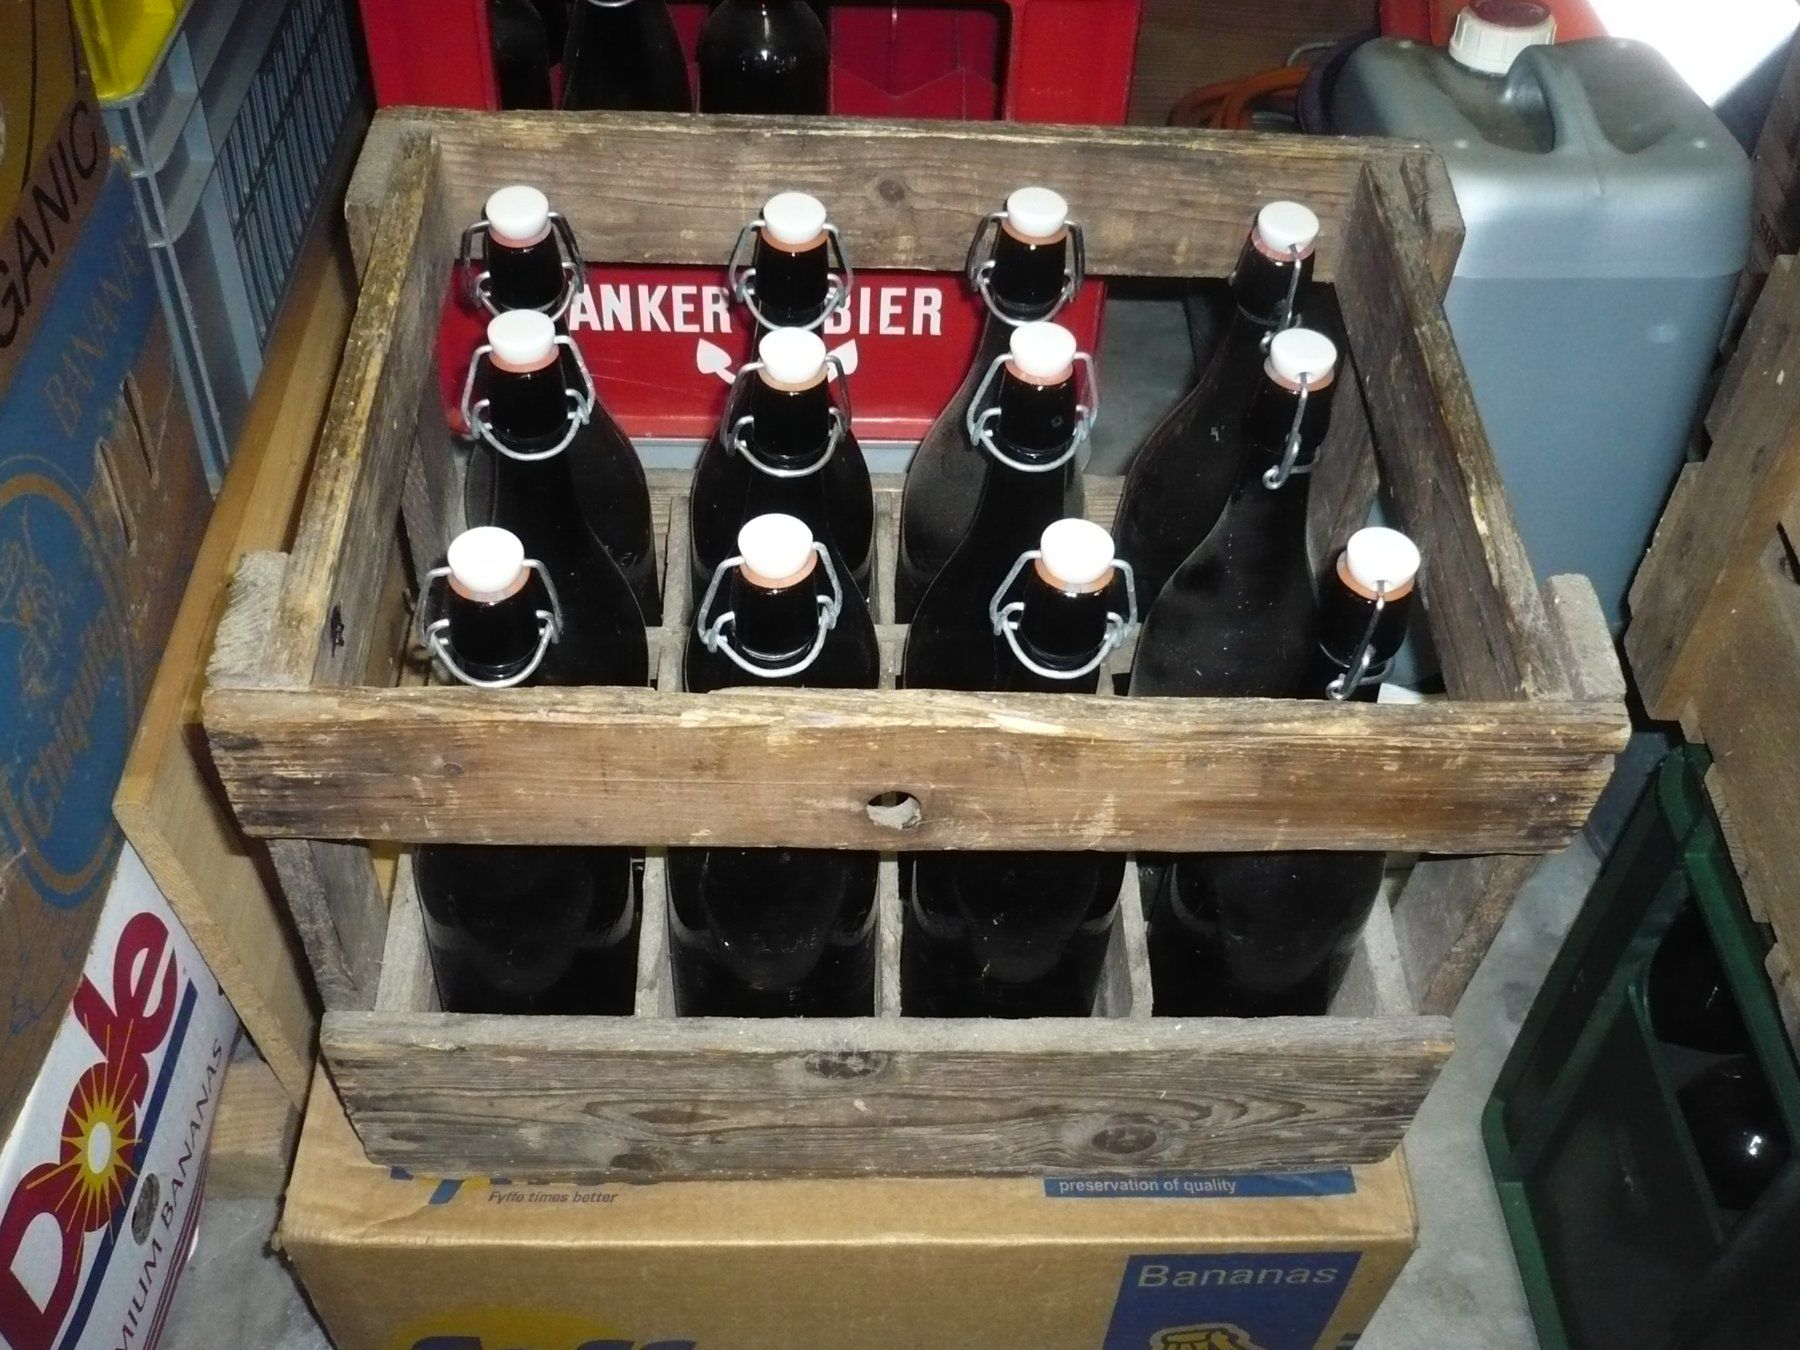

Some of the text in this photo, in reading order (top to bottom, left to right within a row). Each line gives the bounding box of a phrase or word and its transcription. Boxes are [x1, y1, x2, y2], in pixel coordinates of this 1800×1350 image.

[569, 284, 942, 335] ANKER BIER
[0, 911, 177, 1350] Dole
[160, 1038, 222, 1230] BANANAS
[488, 1190, 619, 1204] Fyffe times better
[1059, 1178, 1236, 1194] preservation of quality
[1136, 1264, 1338, 1288] Bananas
